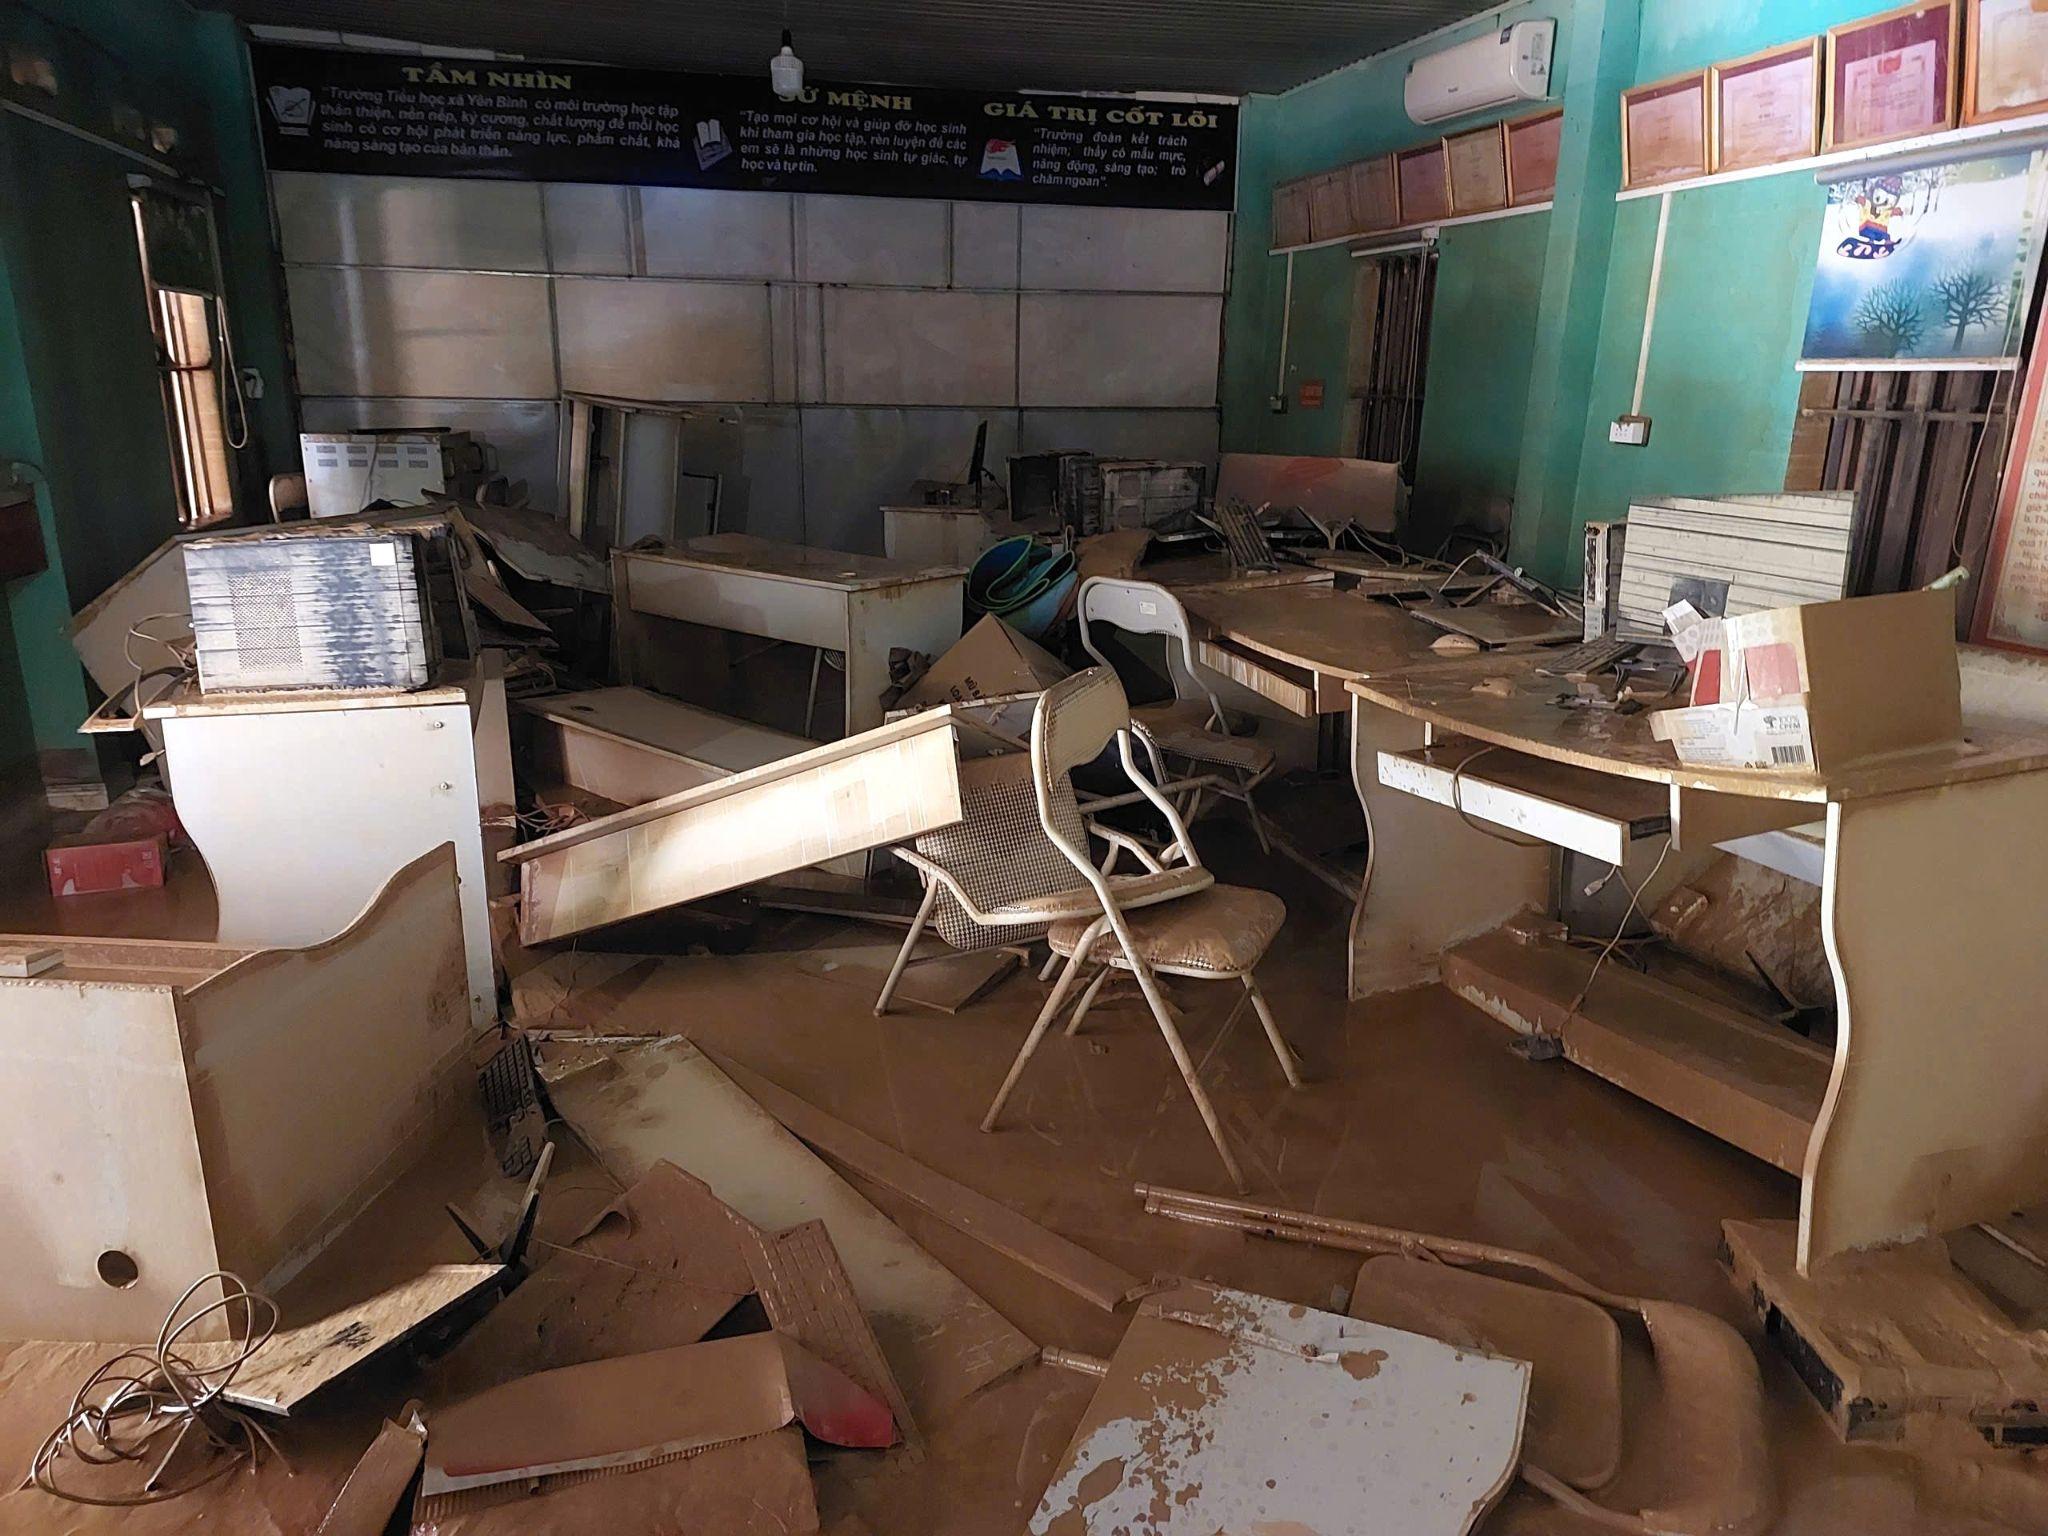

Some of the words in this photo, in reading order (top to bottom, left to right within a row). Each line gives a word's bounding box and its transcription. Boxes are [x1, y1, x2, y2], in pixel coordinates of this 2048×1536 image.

[487, 70, 572, 90] NHÌN
[419, 92, 445, 107] học
[467, 94, 493, 107] Yên
[496, 95, 527, 109] Bình
[535, 97, 550, 110] có
[554, 99, 579, 111] môi
[582, 100, 628, 116] trường
[631, 102, 655, 118] học
[658, 104, 679, 119] tập
[827, 90, 912, 111] MỆNH
[320, 103, 352, 116] thân
[533, 113, 563, 127] chất
[565, 115, 604, 131] lượng
[655, 120, 679, 134] học
[983, 100, 1039, 118] GIÁ
[1047, 105, 1097, 125] TRỊ
[1106, 105, 1164, 125] CỐT
[774, 113, 797, 126] mọi
[801, 115, 818, 125] cơ
[821, 114, 842, 129] hội
[845, 117, 859, 128] và
[863, 118, 890, 132] giúp
[915, 121, 937, 134] học
[941, 122, 967, 135] sinh
[322, 121, 353, 134] sinh
[359, 124, 376, 135] có
[382, 125, 401, 136] cơ
[406, 125, 428, 139] hội
[433, 127, 465, 143] phát
[507, 129, 541, 145] năng
[577, 130, 614, 146] phẩm
[657, 135, 680, 149] khả
[740, 126, 759, 138] khi
[762, 127, 793, 139] tham
[796, 130, 815, 143] gia
[819, 130, 841, 144] học
[870, 133, 890, 145] rèn
[893, 135, 925, 149] luyện
[929, 135, 943, 149] để
[946, 138, 967, 150] các
[1093, 131, 1122, 143] đoàn
[1131, 132, 1150, 144] kết
[1158, 134, 1187, 146] trách
[324, 138, 360, 153] năng
[362, 139, 397, 154] sáng
[399, 140, 421, 155] tạo
[451, 142, 476, 155] bản
[740, 144, 759, 154] em
[784, 143, 795, 155] là
[800, 146, 840, 160] những
[845, 147, 868, 162] học
[873, 149, 899, 161] sinh
[903, 151, 918, 164] tự
[954, 154, 968, 168] tự
[1083, 145, 1107, 160] thầy
[741, 157, 765, 172] học
[767, 159, 781, 170] và
[1032, 159, 1061, 172] năng
[1104, 162, 1131, 175] sáng
[1171, 165, 1186, 176] trò
